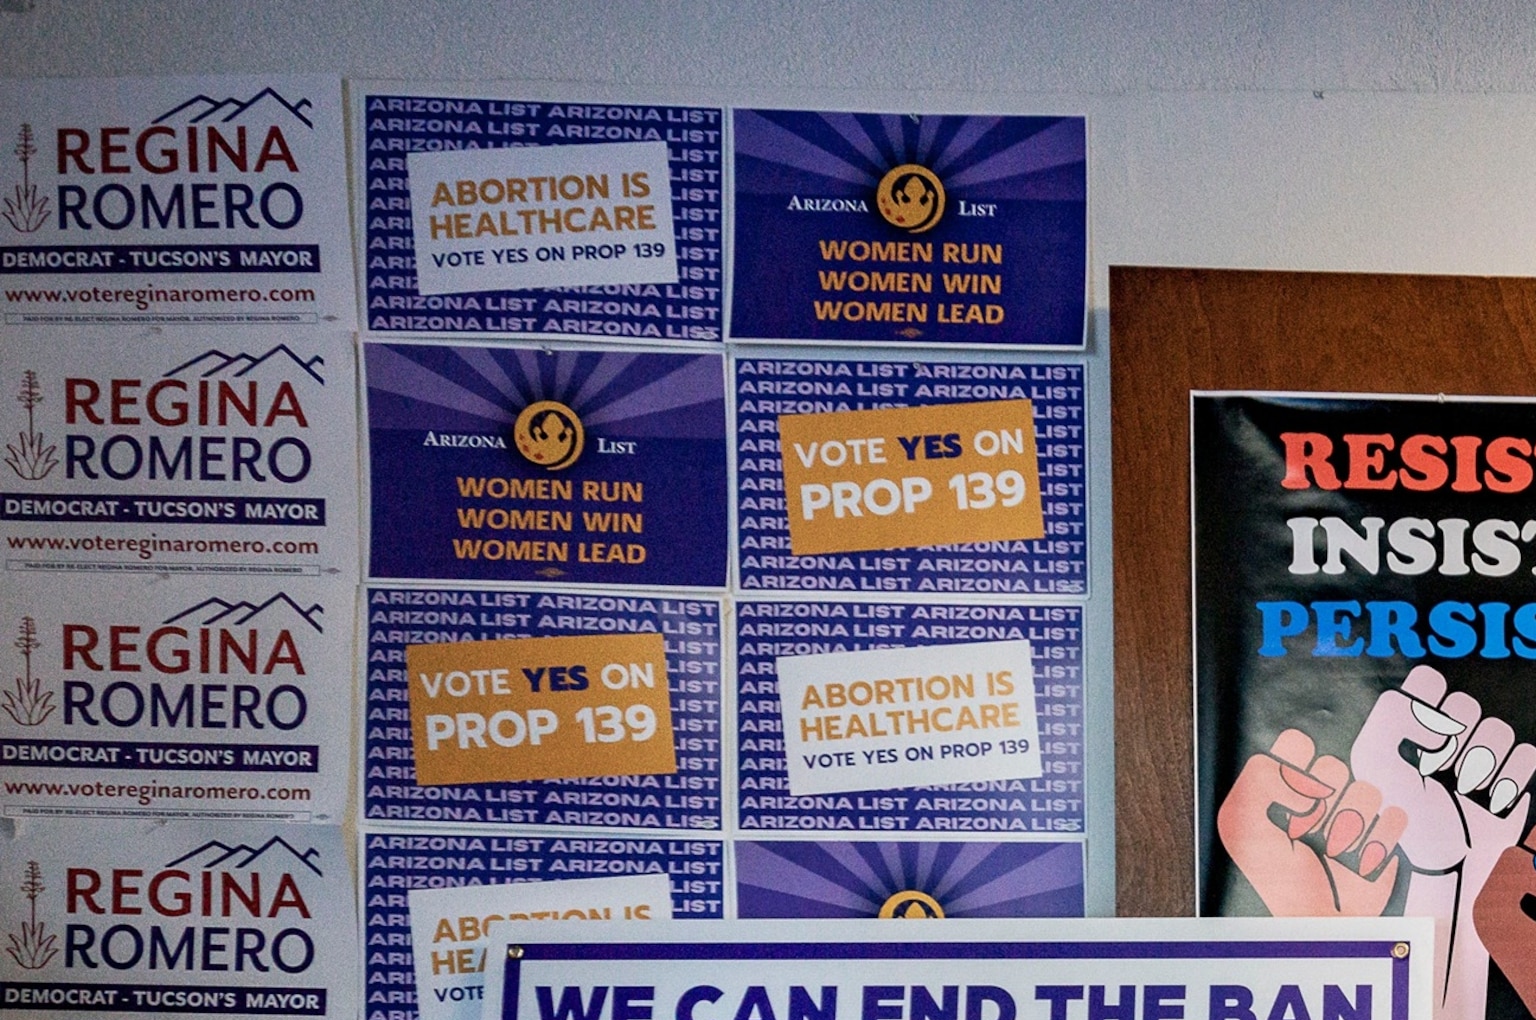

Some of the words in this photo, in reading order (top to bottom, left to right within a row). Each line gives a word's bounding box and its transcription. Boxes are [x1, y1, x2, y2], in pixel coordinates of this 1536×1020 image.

[57, 125, 299, 175] REGINA
[58, 182, 304, 230] ROMERO
[431, 173, 609, 208] ABORTION
[622, 172, 651, 198] IS
[429, 204, 657, 240] HEALTHCARE
[432, 250, 485, 268] VOTE
[492, 248, 528, 265] YES
[535, 247, 565, 262] ON
[571, 244, 627, 260] PROP
[633, 242, 665, 259] 139
[819, 239, 933, 263] WOMEN
[943, 243, 1003, 265] RUN
[5, 284, 315, 310] www.votereginaromero.com
[818, 270, 932, 293] WOMEN
[942, 273, 1001, 295] WIN
[813, 300, 928, 323] WOMEN
[937, 303, 1004, 325] LEAD
[65, 377, 308, 428] REGINA
[65, 434, 312, 484] ROMERO
[794, 438, 887, 468] VOTE
[897, 433, 963, 461] YES
[973, 428, 1024, 457] ON
[456, 476, 572, 500] WOMEN
[582, 481, 643, 502] RUN
[800, 476, 933, 521] PROP
[948, 469, 1026, 510] 139
[456, 508, 572, 531] WOMEN
[582, 511, 643, 534] WIN
[7, 534, 319, 559] www.votereginaromero.com
[452, 538, 568, 562] WOMEN
[578, 542, 647, 564] LEAD
[62, 623, 306, 676] REGINA
[420, 669, 511, 699] VOTE
[521, 665, 590, 693] YES
[600, 662, 655, 690] ON
[800, 673, 975, 711] ABORTION
[987, 671, 1015, 697] IS
[63, 680, 308, 731] ROMERO
[799, 703, 1021, 742] HEALTHCARE
[425, 709, 558, 751] PROP
[575, 704, 658, 745] 139
[3, 744, 120, 763] DEMOCRAT
[137, 748, 234, 766] TUCSON'S
[243, 750, 312, 766] MAYOR
[803, 752, 856, 770] VOTE
[862, 749, 898, 765] YES
[905, 746, 934, 762] ON
[940, 742, 992, 759] PROP
[999, 739, 1030, 755] 139
[5, 780, 311, 805] www.votereginaromero.com
[66, 867, 312, 919] REGINA
[65, 923, 315, 974] ROMERO
[5, 987, 117, 1005] DEMOCRAT
[135, 990, 236, 1009] TUCSON'S
[246, 992, 320, 1010] MAYOR
